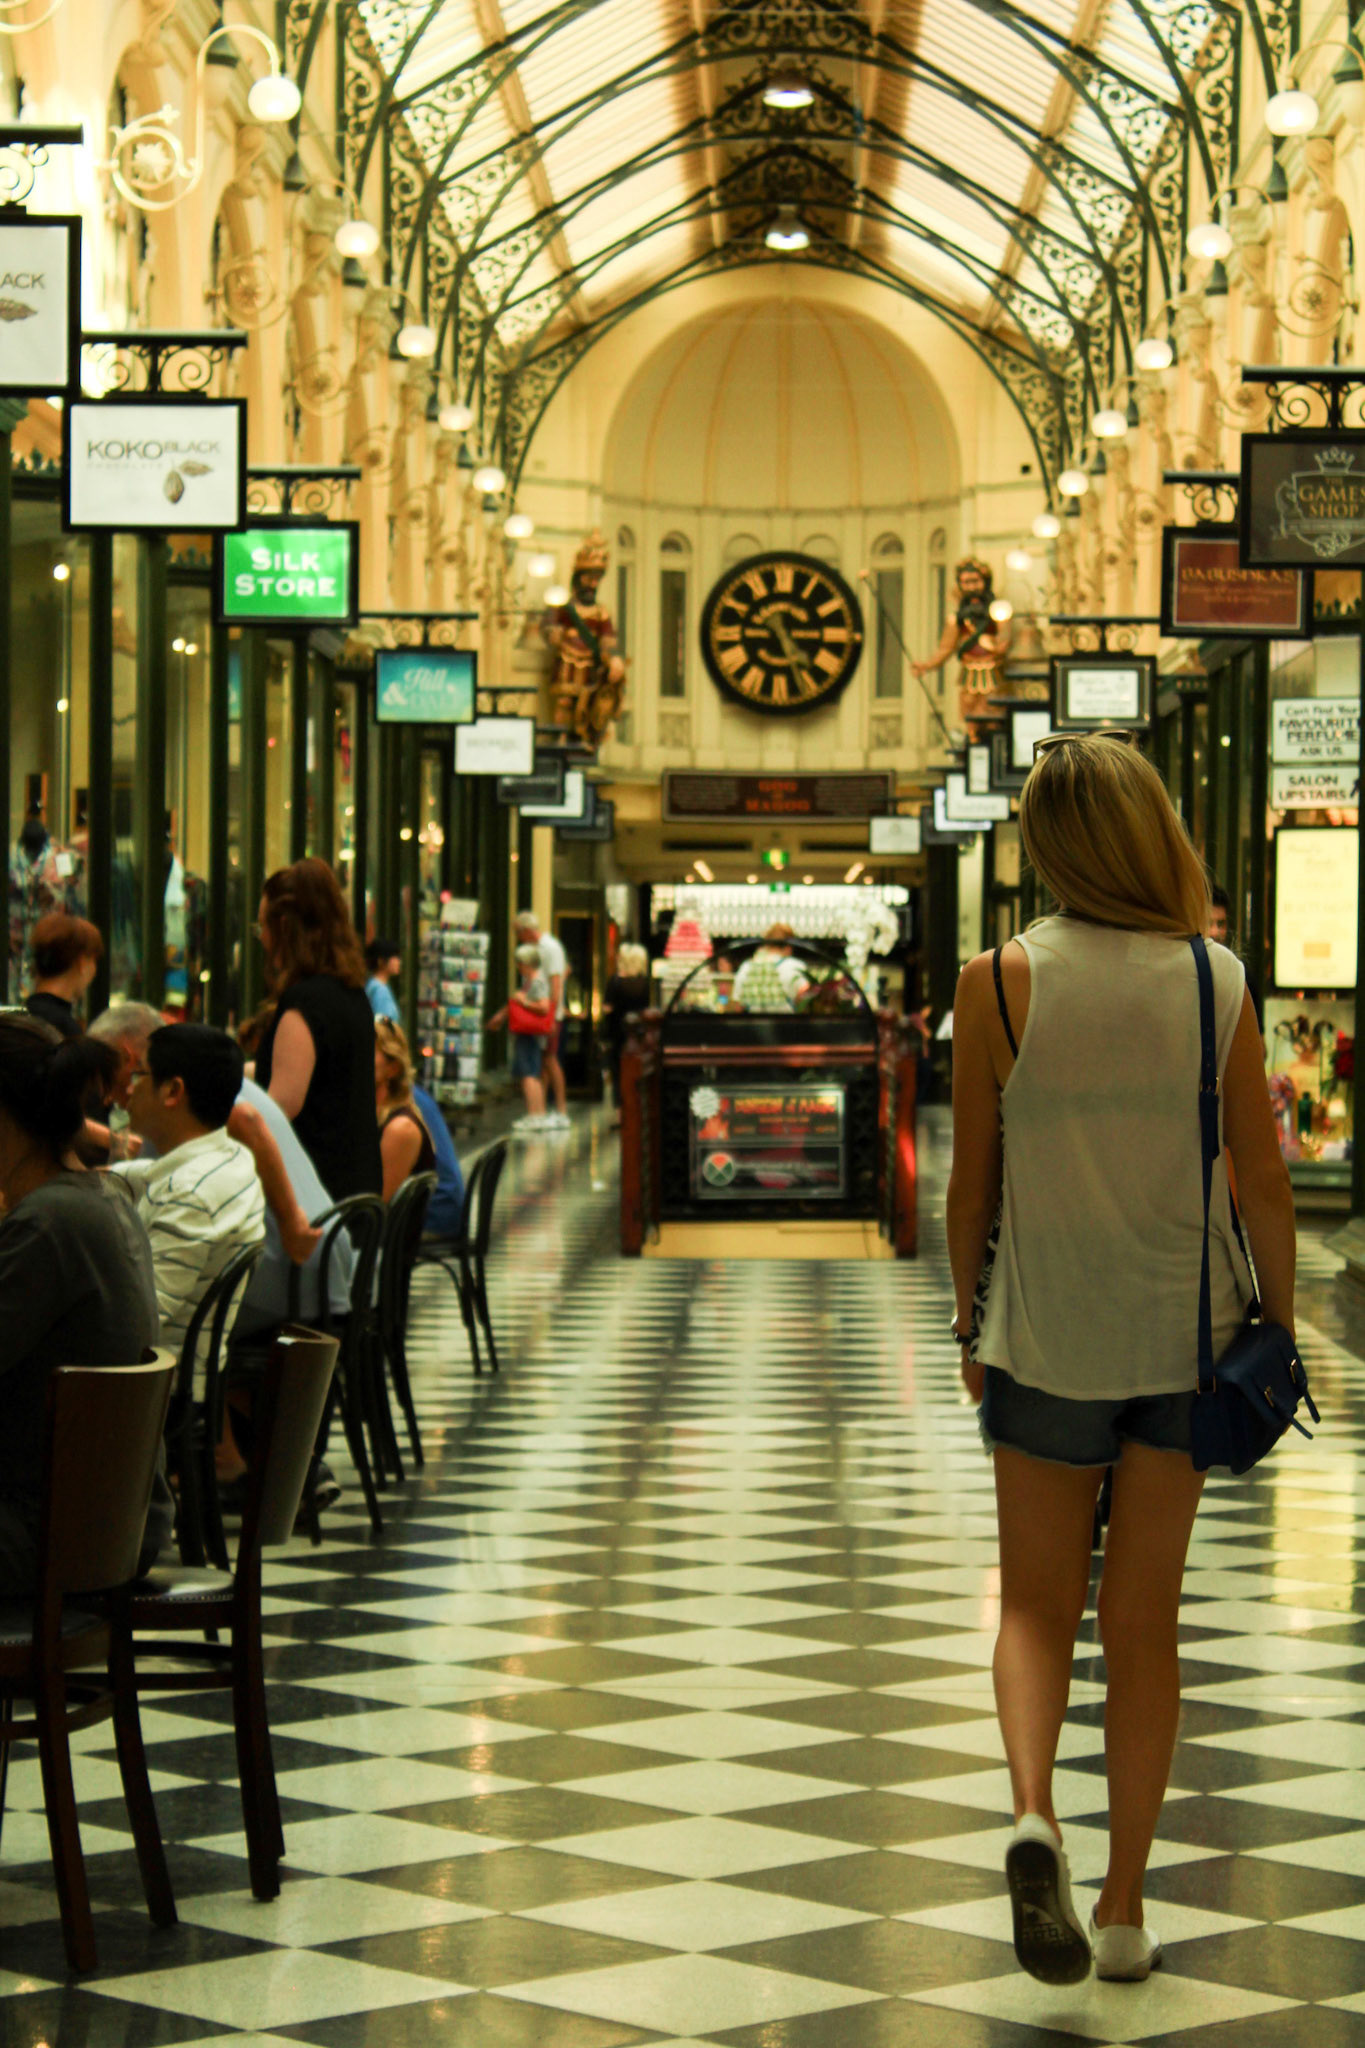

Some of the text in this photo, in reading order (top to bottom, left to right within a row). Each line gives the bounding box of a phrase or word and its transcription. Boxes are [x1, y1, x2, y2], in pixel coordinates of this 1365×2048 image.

[0, 272, 46, 289] ACK
[1310, 504, 1359, 518] SHOP
[251, 547, 320, 572] SILK
[235, 574, 336, 597] STORE
[1288, 775, 1339, 786] SALON
[1279, 790, 1347, 801] UPSTAIRS
